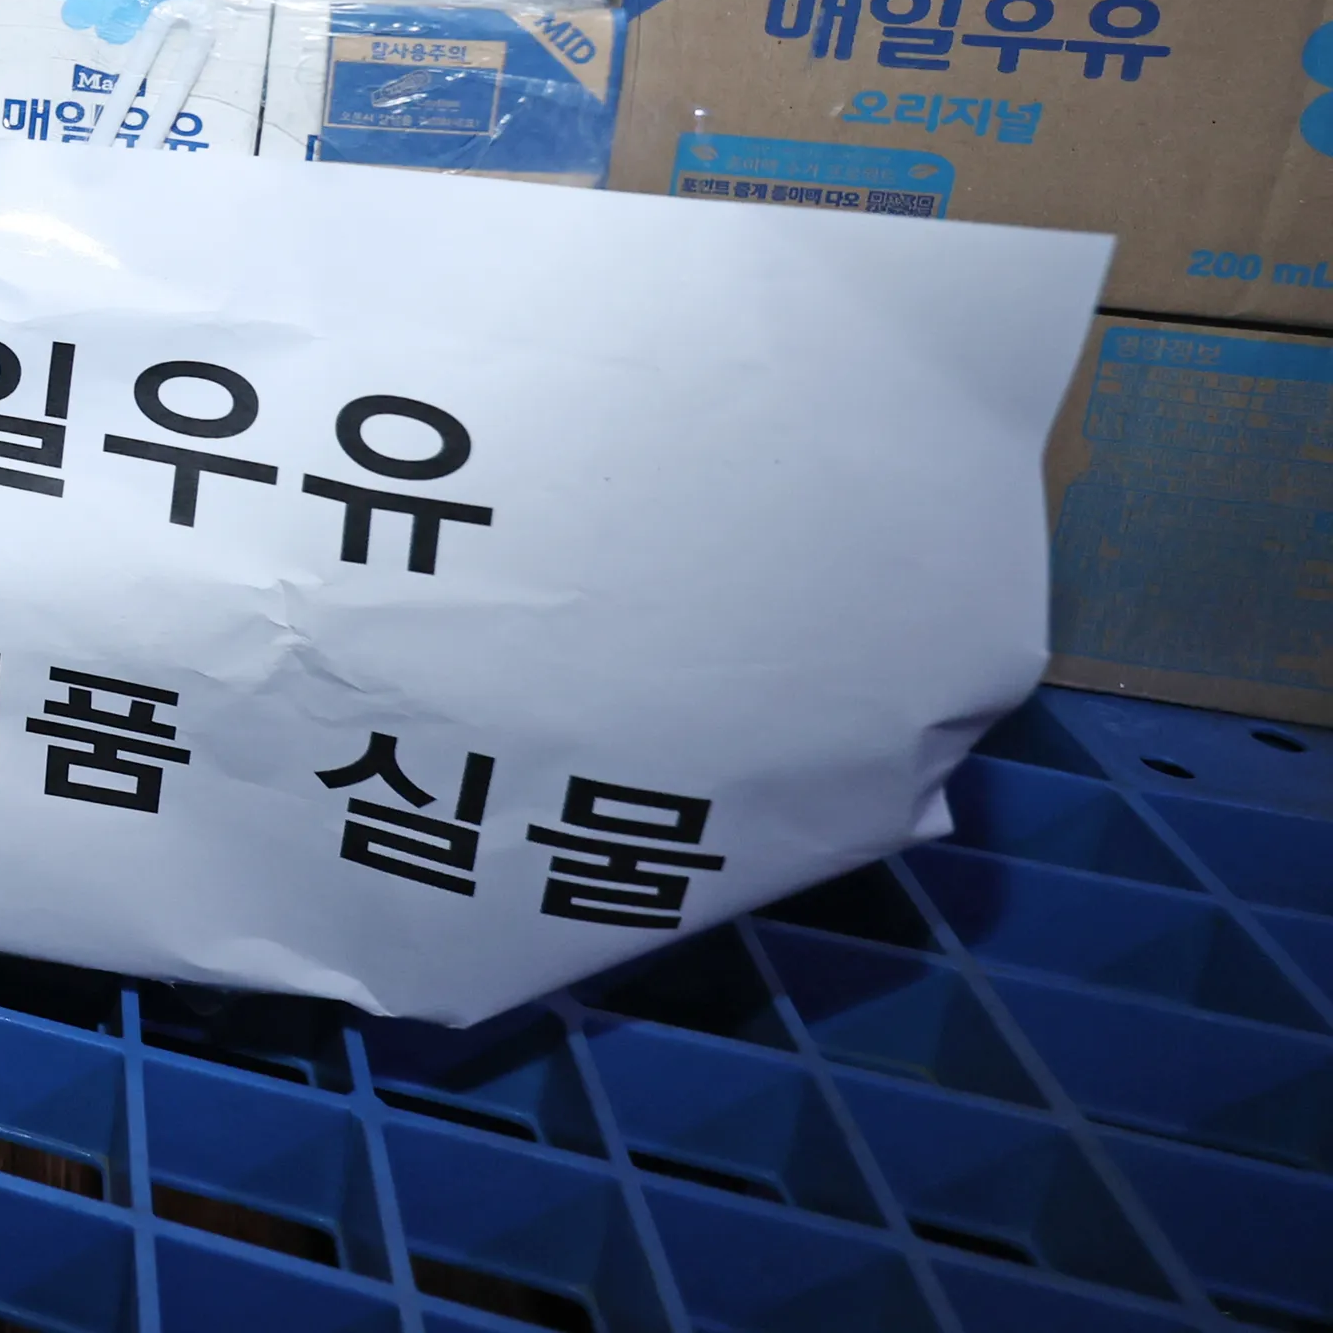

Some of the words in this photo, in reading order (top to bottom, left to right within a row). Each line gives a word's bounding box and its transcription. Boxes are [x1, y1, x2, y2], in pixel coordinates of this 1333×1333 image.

[371, 41, 467, 62] 칼사용주의
[535, 11, 597, 65] MID
[842, 88, 1043, 144] 오리지널
[1187, 249, 1262, 281] 200
[314, 731, 726, 929] 실물
